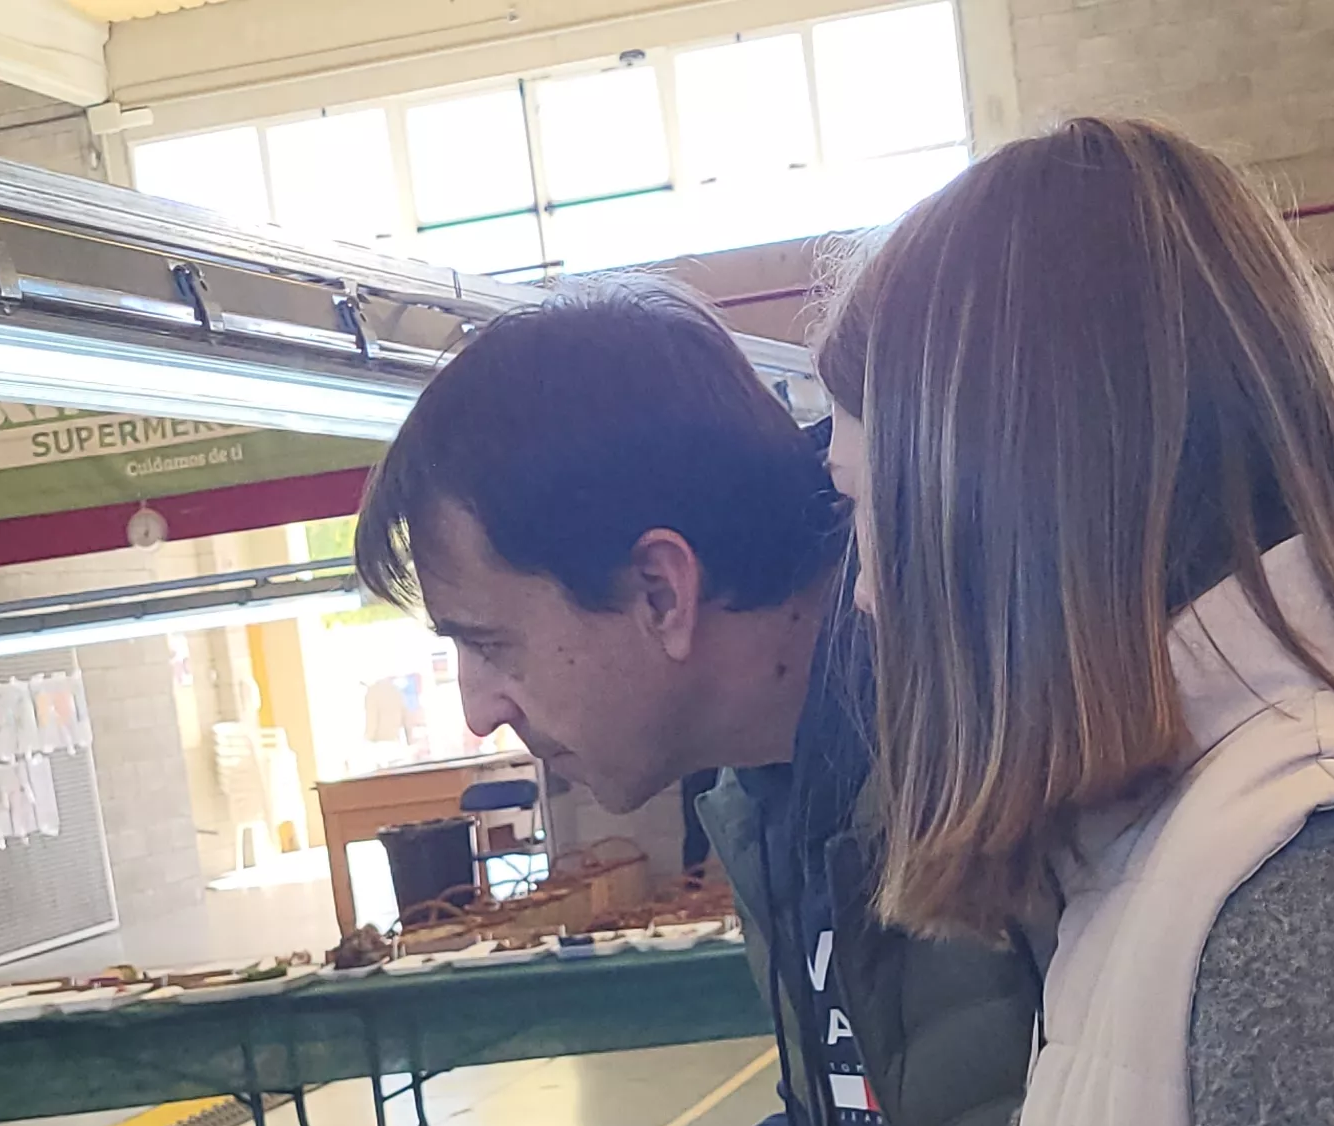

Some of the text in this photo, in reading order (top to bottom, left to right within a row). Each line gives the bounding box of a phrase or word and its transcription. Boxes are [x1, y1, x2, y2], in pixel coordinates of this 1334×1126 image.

[126, 444, 243, 477] Cuidamos de ti
